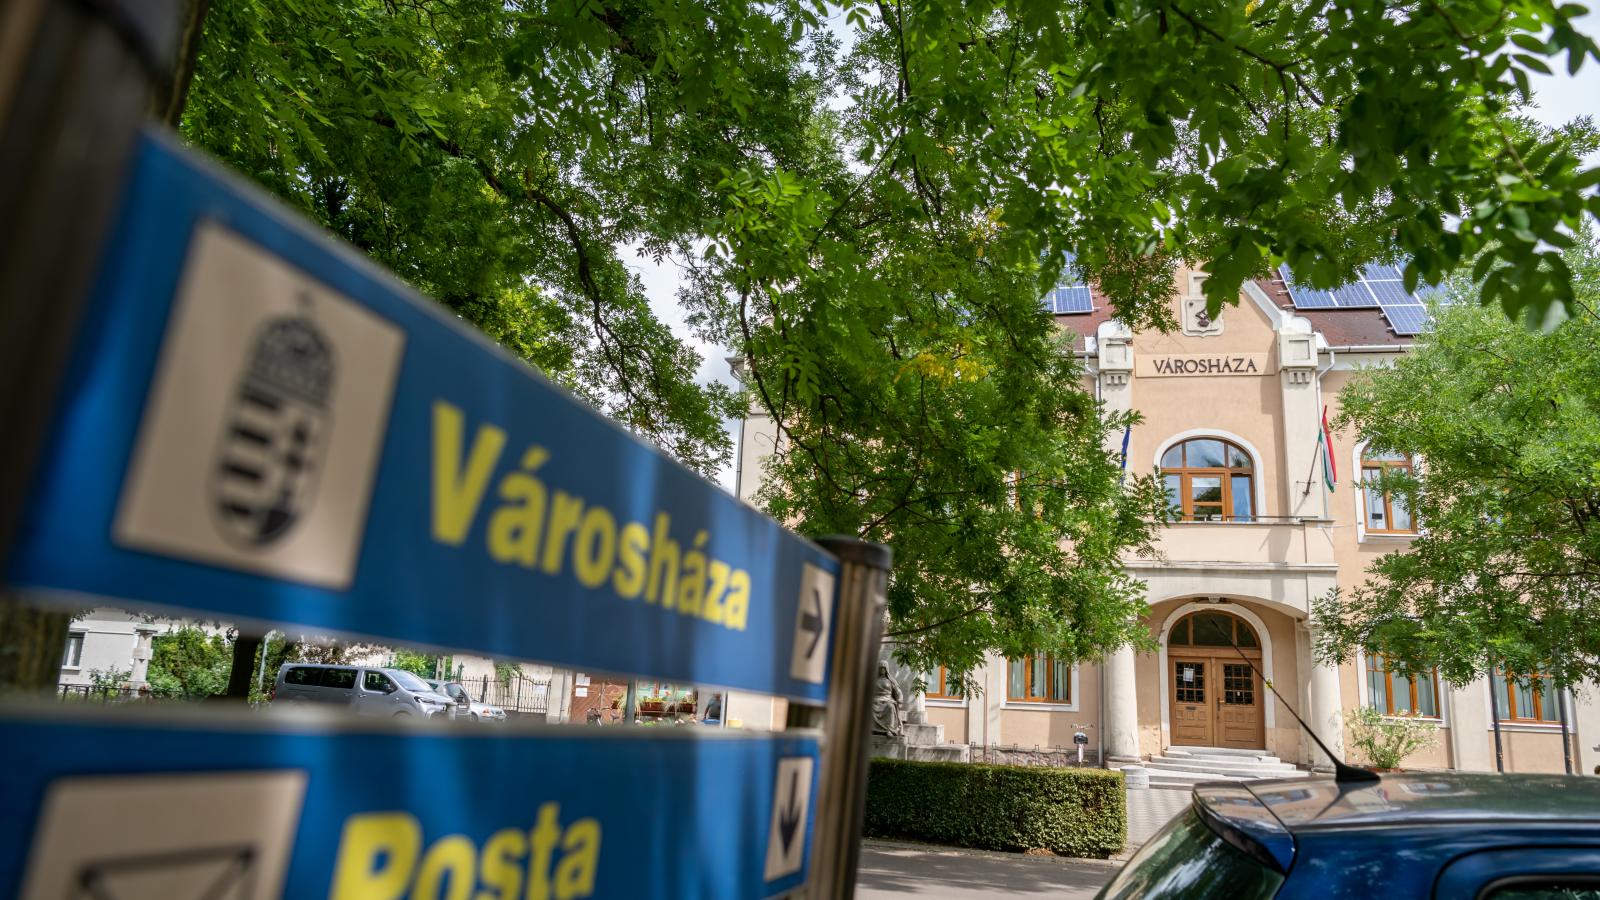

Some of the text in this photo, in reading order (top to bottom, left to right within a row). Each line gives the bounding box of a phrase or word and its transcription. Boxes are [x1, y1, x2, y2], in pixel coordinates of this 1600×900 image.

[1153, 356, 1257, 374] VÁROSHÁZA
[431, 400, 751, 631] Városháza
[329, 801, 602, 900] Posta
